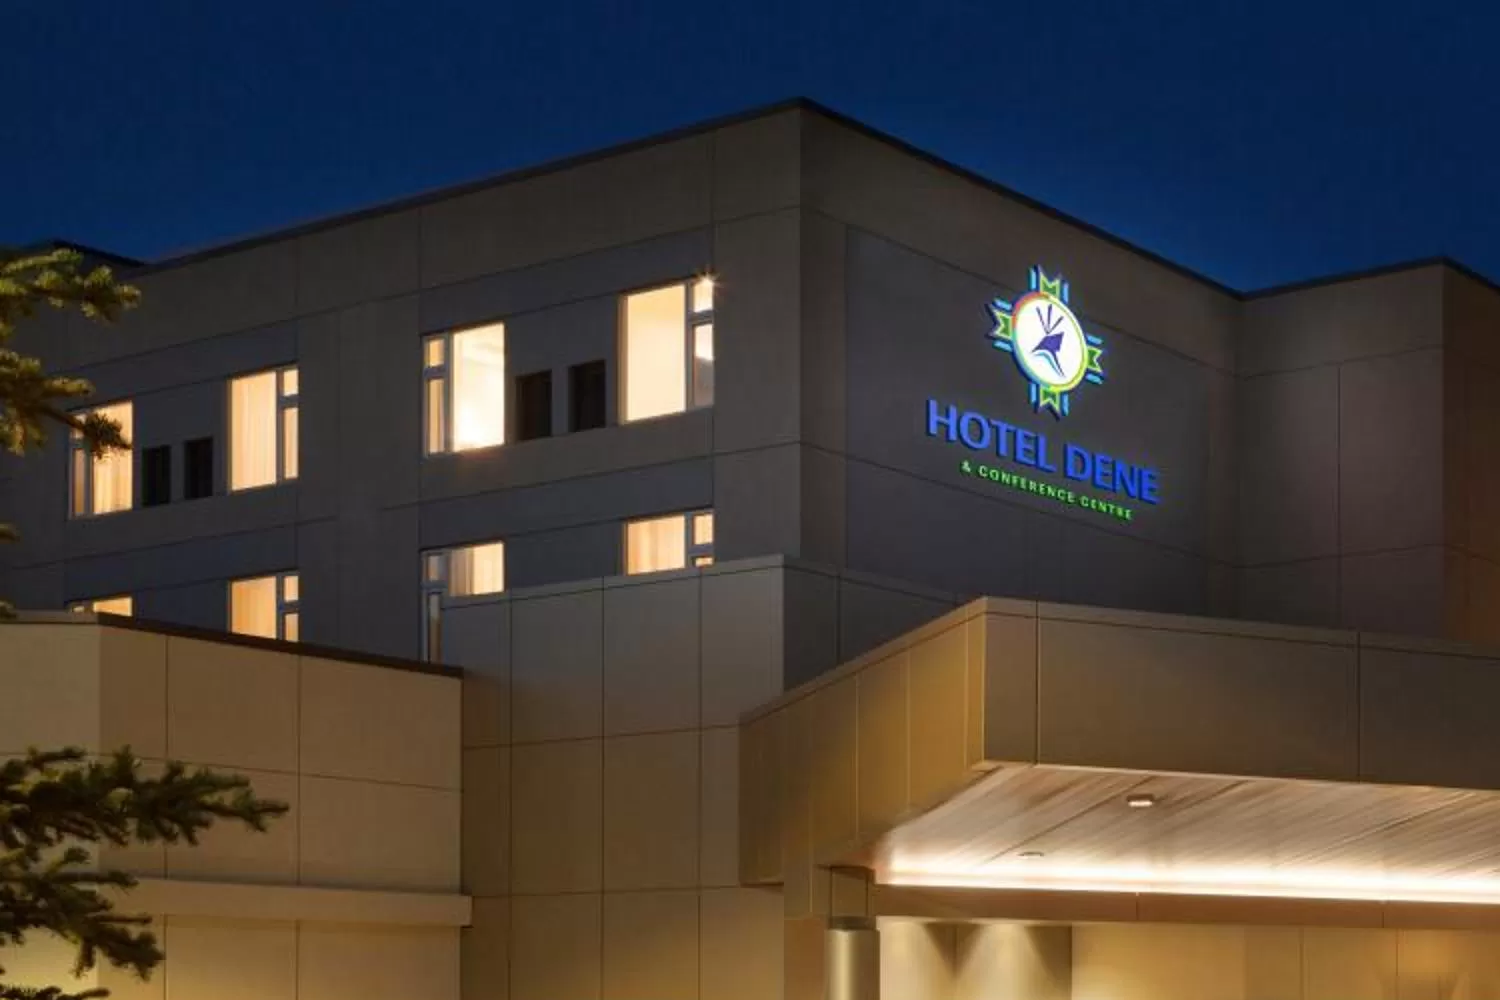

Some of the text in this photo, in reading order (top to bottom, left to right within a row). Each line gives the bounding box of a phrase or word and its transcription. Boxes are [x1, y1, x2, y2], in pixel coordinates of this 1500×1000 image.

[927, 399, 1160, 504] HOTEL DENE
[960, 459, 1133, 521] & CONFERENCE CENTRE
